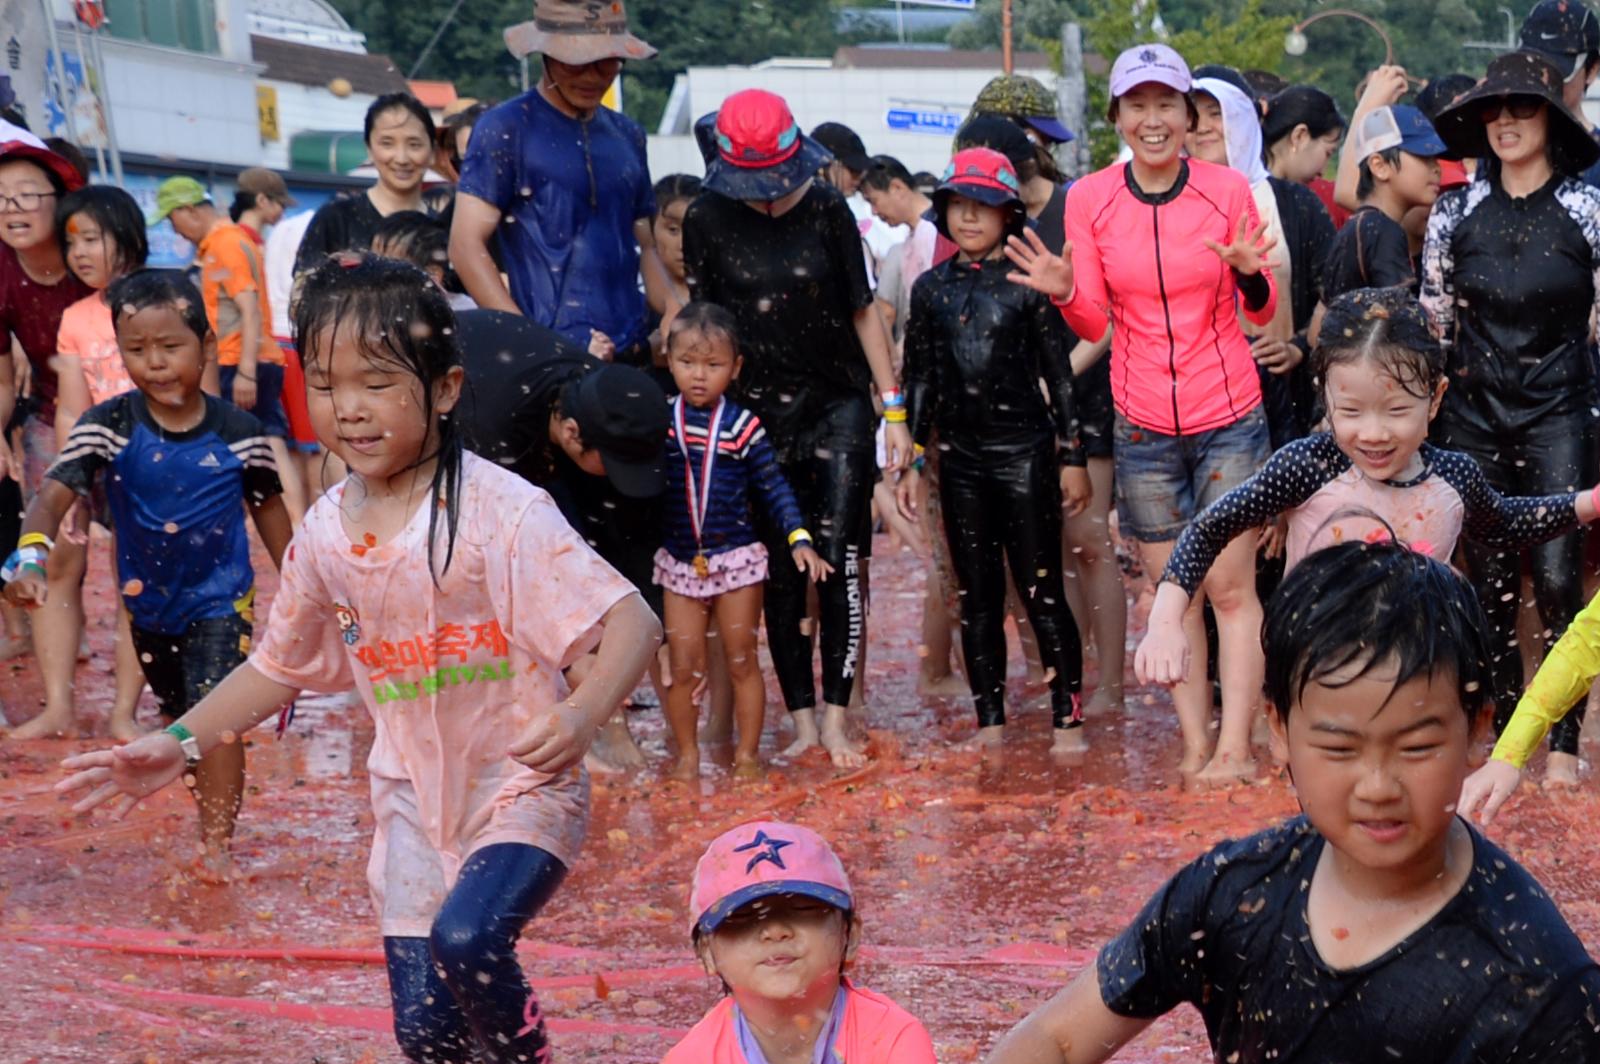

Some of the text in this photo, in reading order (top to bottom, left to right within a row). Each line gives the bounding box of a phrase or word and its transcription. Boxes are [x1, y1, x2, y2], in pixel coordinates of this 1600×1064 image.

[843, 544, 863, 679] THE NORTH FACE
